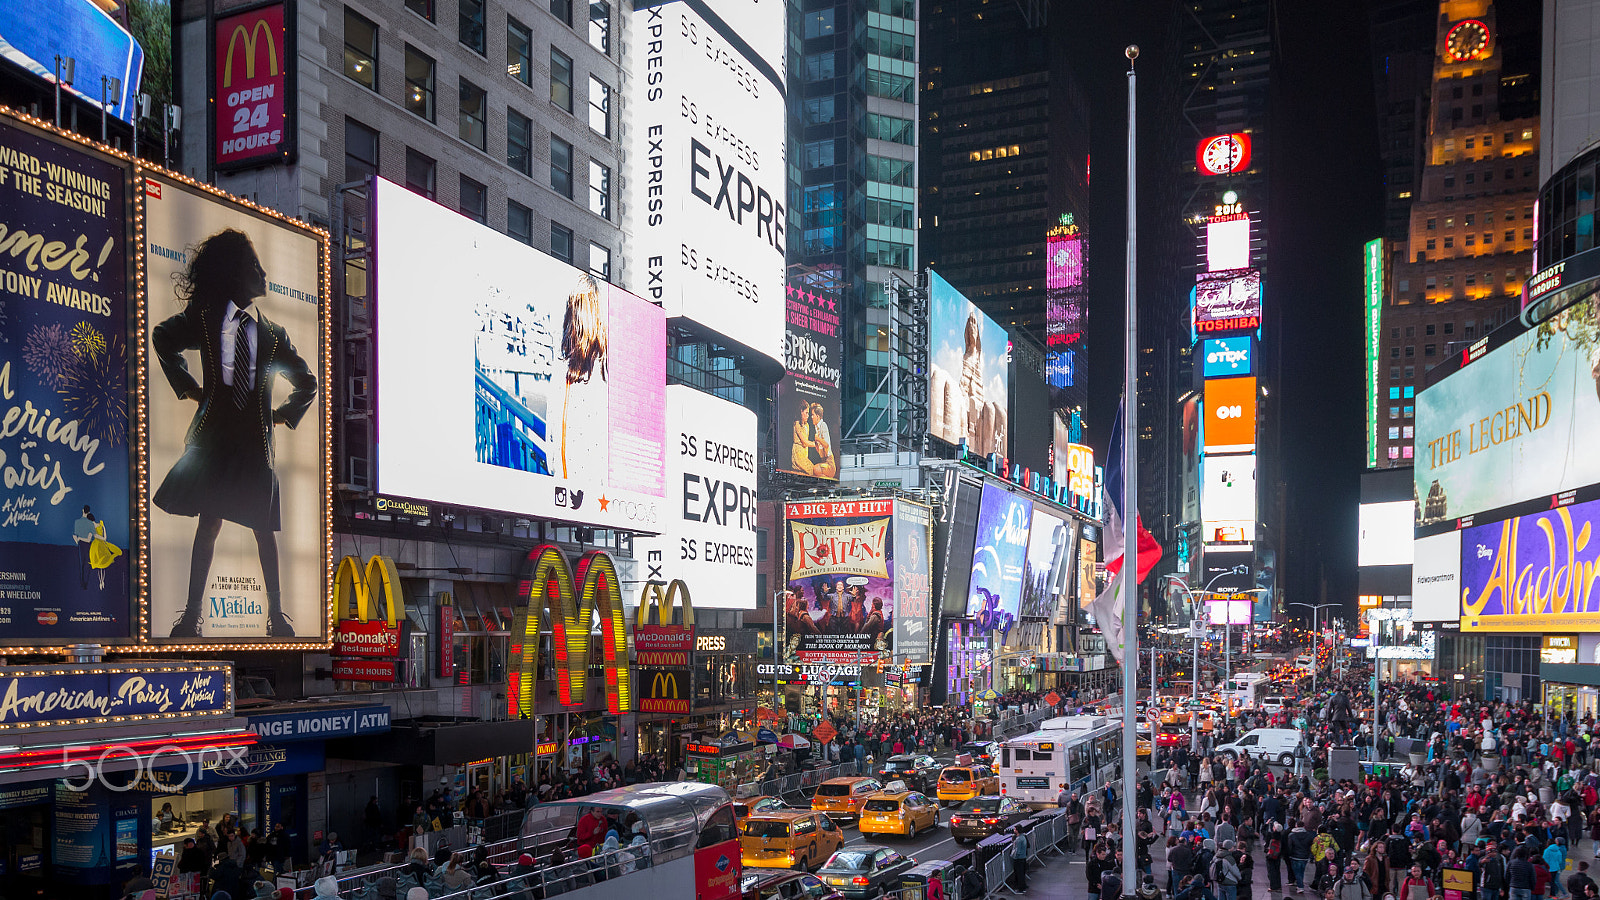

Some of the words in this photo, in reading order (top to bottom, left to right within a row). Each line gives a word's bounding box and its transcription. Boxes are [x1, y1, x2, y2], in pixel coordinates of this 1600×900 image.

[706, 36, 759, 99] EXPRESS
[228, 84, 274, 107] OPEN
[233, 103, 270, 133] 24
[222, 130, 281, 154] HOURS
[706, 114, 759, 170] EXPRESS
[648, 124, 662, 226] EXPRESS
[13, 170, 42, 198] THE
[46, 182, 106, 218] SEASON!
[1208, 212, 1249, 223] TOSHIBA
[1215, 203, 1242, 216] 2016
[151, 243, 187, 264] BROADWAY'S
[706, 257, 759, 303] EXPRESS
[1529, 262, 1566, 288] MARRIOTT
[0, 268, 42, 299] TONY
[46, 282, 112, 317] AWARDS
[269, 282, 288, 296] BIGGEST
[290, 288, 304, 301] LITTLE
[305, 292, 317, 305] HERO
[1529, 276, 1560, 299] MARQUIS
[790, 311, 808, 329] SHEER
[1197, 316, 1258, 332] TOSHIBA
[785, 330, 828, 363] SPRING
[1216, 350, 1248, 363] TDK
[1216, 405, 1242, 420] ON
[1428, 429, 1462, 470] THE
[1469, 390, 1552, 455] LEGEND
[21, 437, 37, 450] in
[705, 440, 754, 473] EXPRESS
[2, 498, 12, 512] A
[12, 494, 37, 512] New
[831, 503, 855, 514] FAT
[2, 509, 41, 527] Musical
[804, 525, 874, 536] SOMETHING
[705, 542, 754, 567] EXPRESS
[899, 564, 929, 592] SCHOOL
[7, 591, 41, 600] WHEELDON
[900, 592, 927, 617] ROCK
[209, 597, 262, 618] Matilda
[333, 632, 397, 644] McDonald's
[636, 633, 691, 641] McDonald's
[696, 636, 725, 650] PRESS
[111, 697, 123, 706] in
[118, 676, 174, 712] Paris
[180, 682, 190, 695] A
[189, 673, 212, 695] New
[180, 689, 216, 711] Musical
[297, 715, 351, 734] MONEY
[360, 713, 389, 728] ATM
[134, 770, 172, 781] MONEY
[127, 780, 184, 795] EXCHANGE
[115, 808, 139, 817] CHANGE
